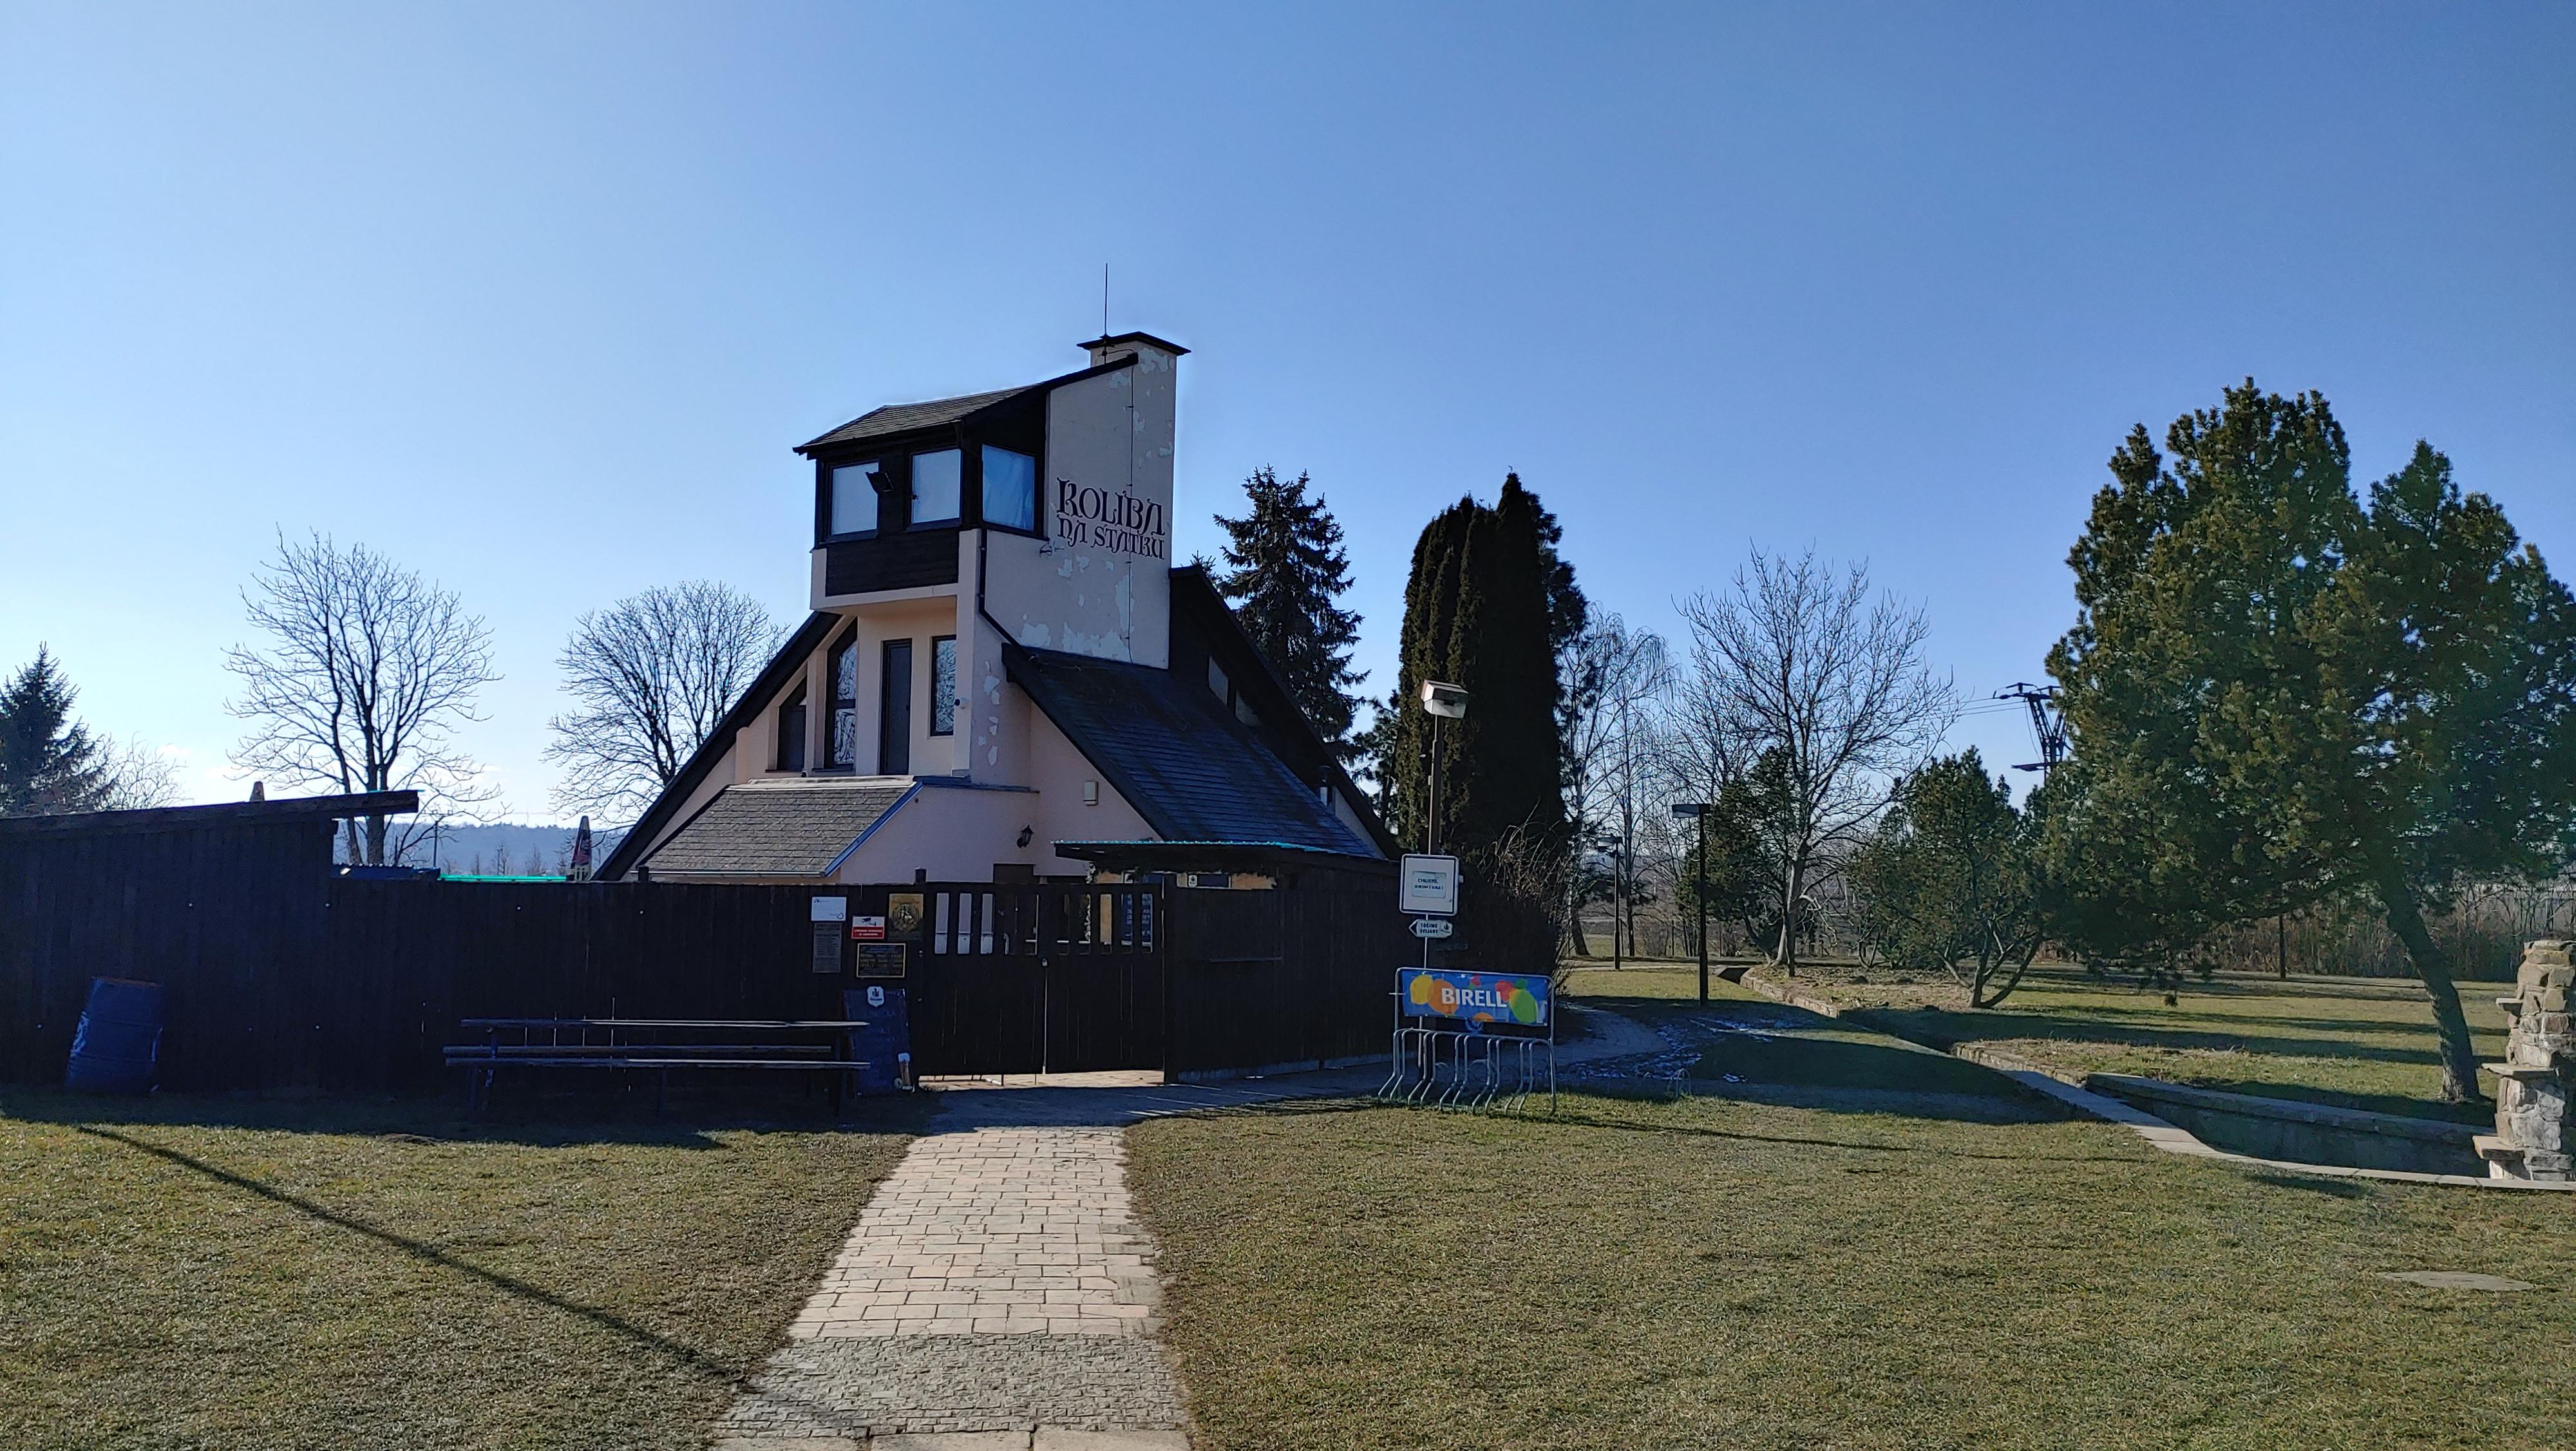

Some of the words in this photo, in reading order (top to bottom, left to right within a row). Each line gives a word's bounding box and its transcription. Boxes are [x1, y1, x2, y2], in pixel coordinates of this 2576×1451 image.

[1057, 477, 1165, 536] KOLIBA
[1057, 515, 1088, 547] NA
[1090, 524, 1165, 560] STATKU
[1441, 987, 1507, 1008] BIRELL
